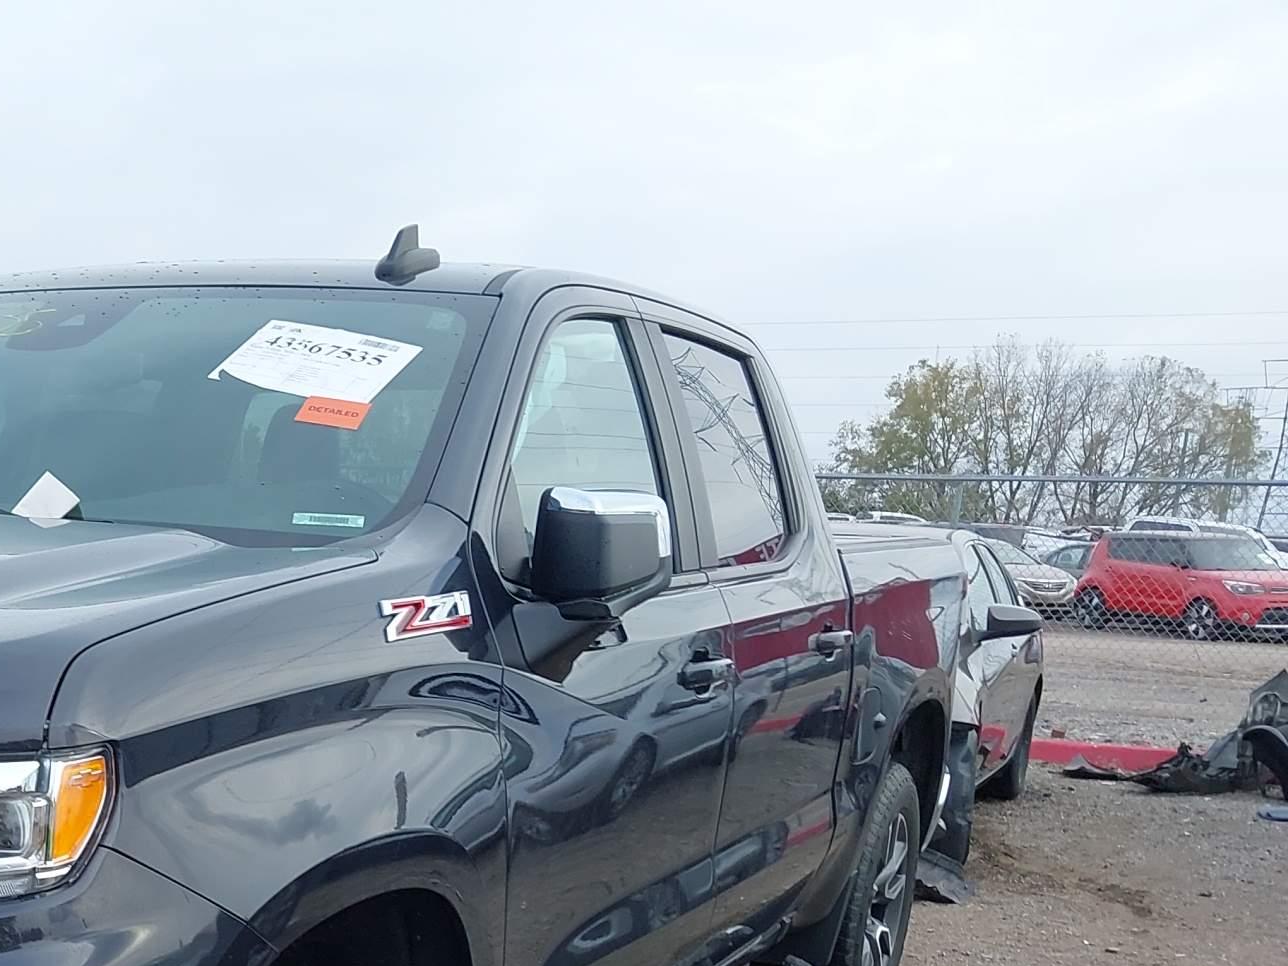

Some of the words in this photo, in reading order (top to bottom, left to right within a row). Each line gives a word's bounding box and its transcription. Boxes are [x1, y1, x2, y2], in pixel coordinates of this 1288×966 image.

[264, 335, 389, 367] 43567535
[307, 404, 360, 419] DETAILED
[378, 591, 473, 643] Z71
